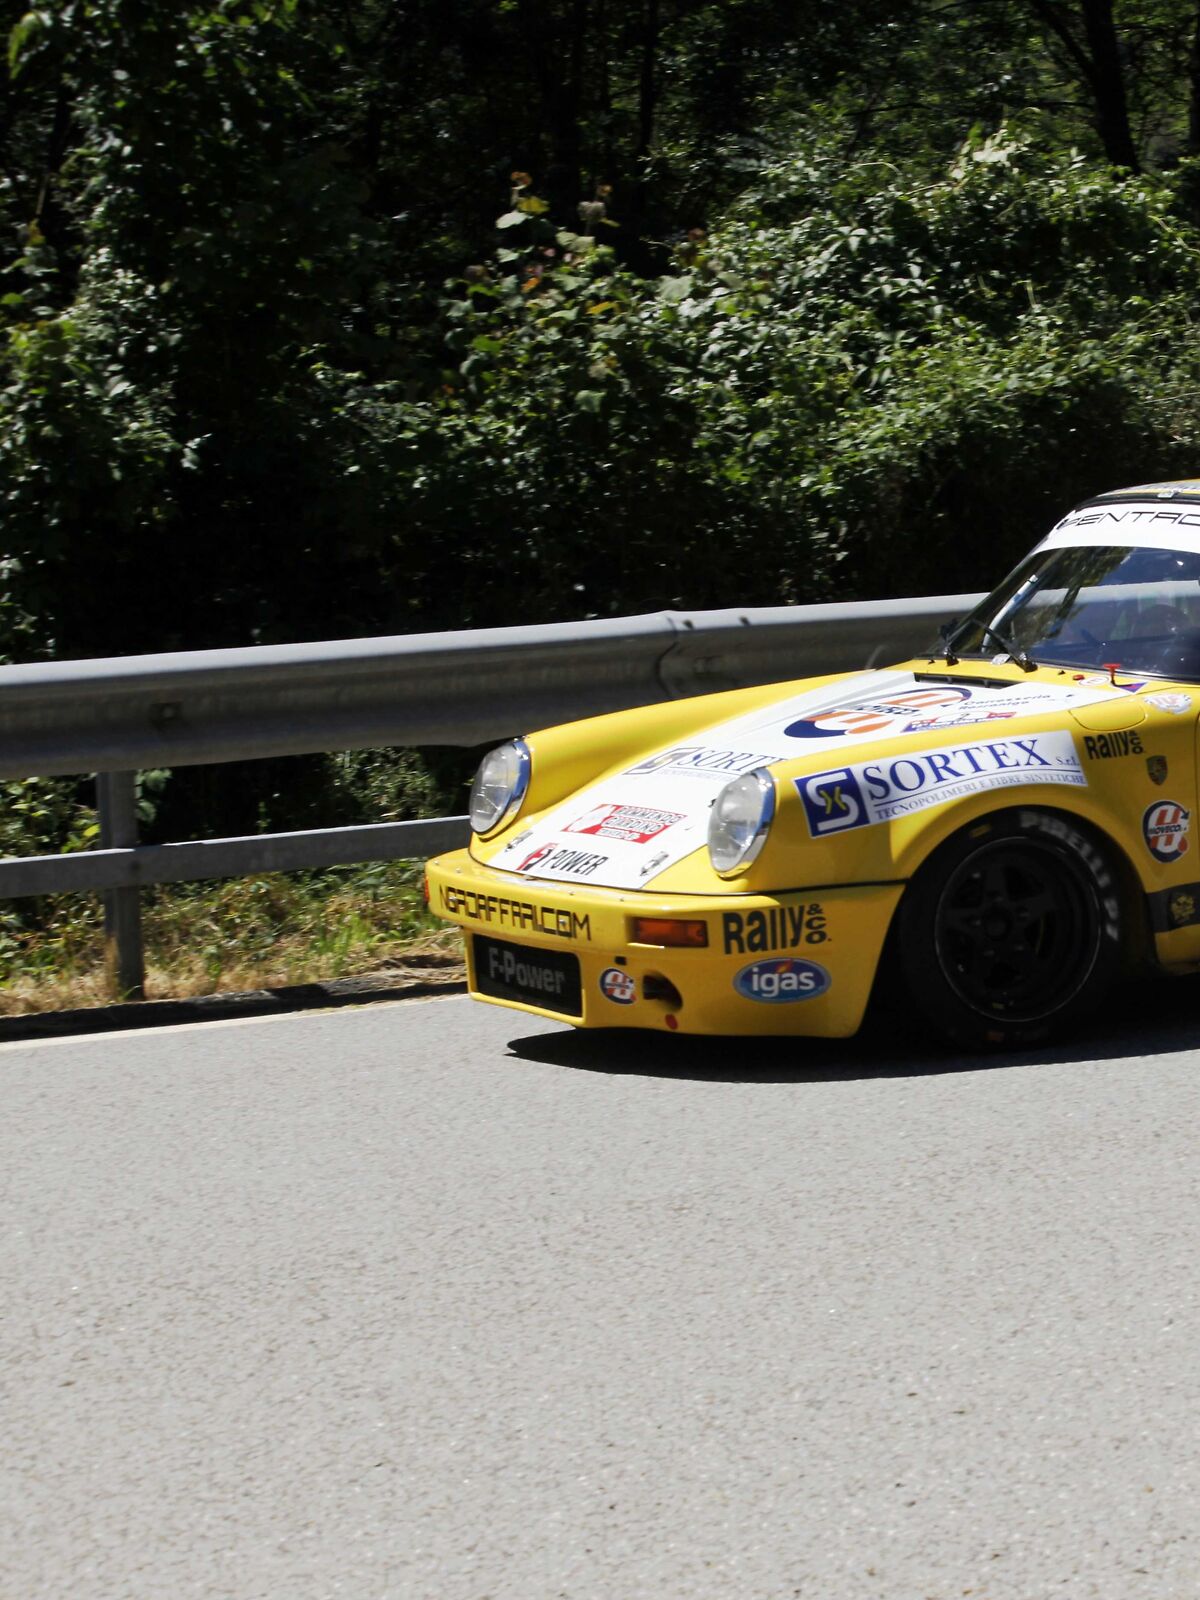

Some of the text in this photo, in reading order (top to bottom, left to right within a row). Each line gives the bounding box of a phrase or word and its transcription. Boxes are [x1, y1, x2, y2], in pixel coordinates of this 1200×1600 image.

[1083, 731, 1129, 760] Rally
[862, 739, 1052, 801] SORTEX
[875, 782, 978, 821] TECNOPOLIMERI
[988, 774, 1023, 788] FIBRE
[1023, 772, 1086, 785] SINTETICHE
[541, 849, 609, 876] POWER
[723, 904, 806, 955] Rally
[489, 946, 567, 993] F-Power
[752, 967, 816, 998] igas
